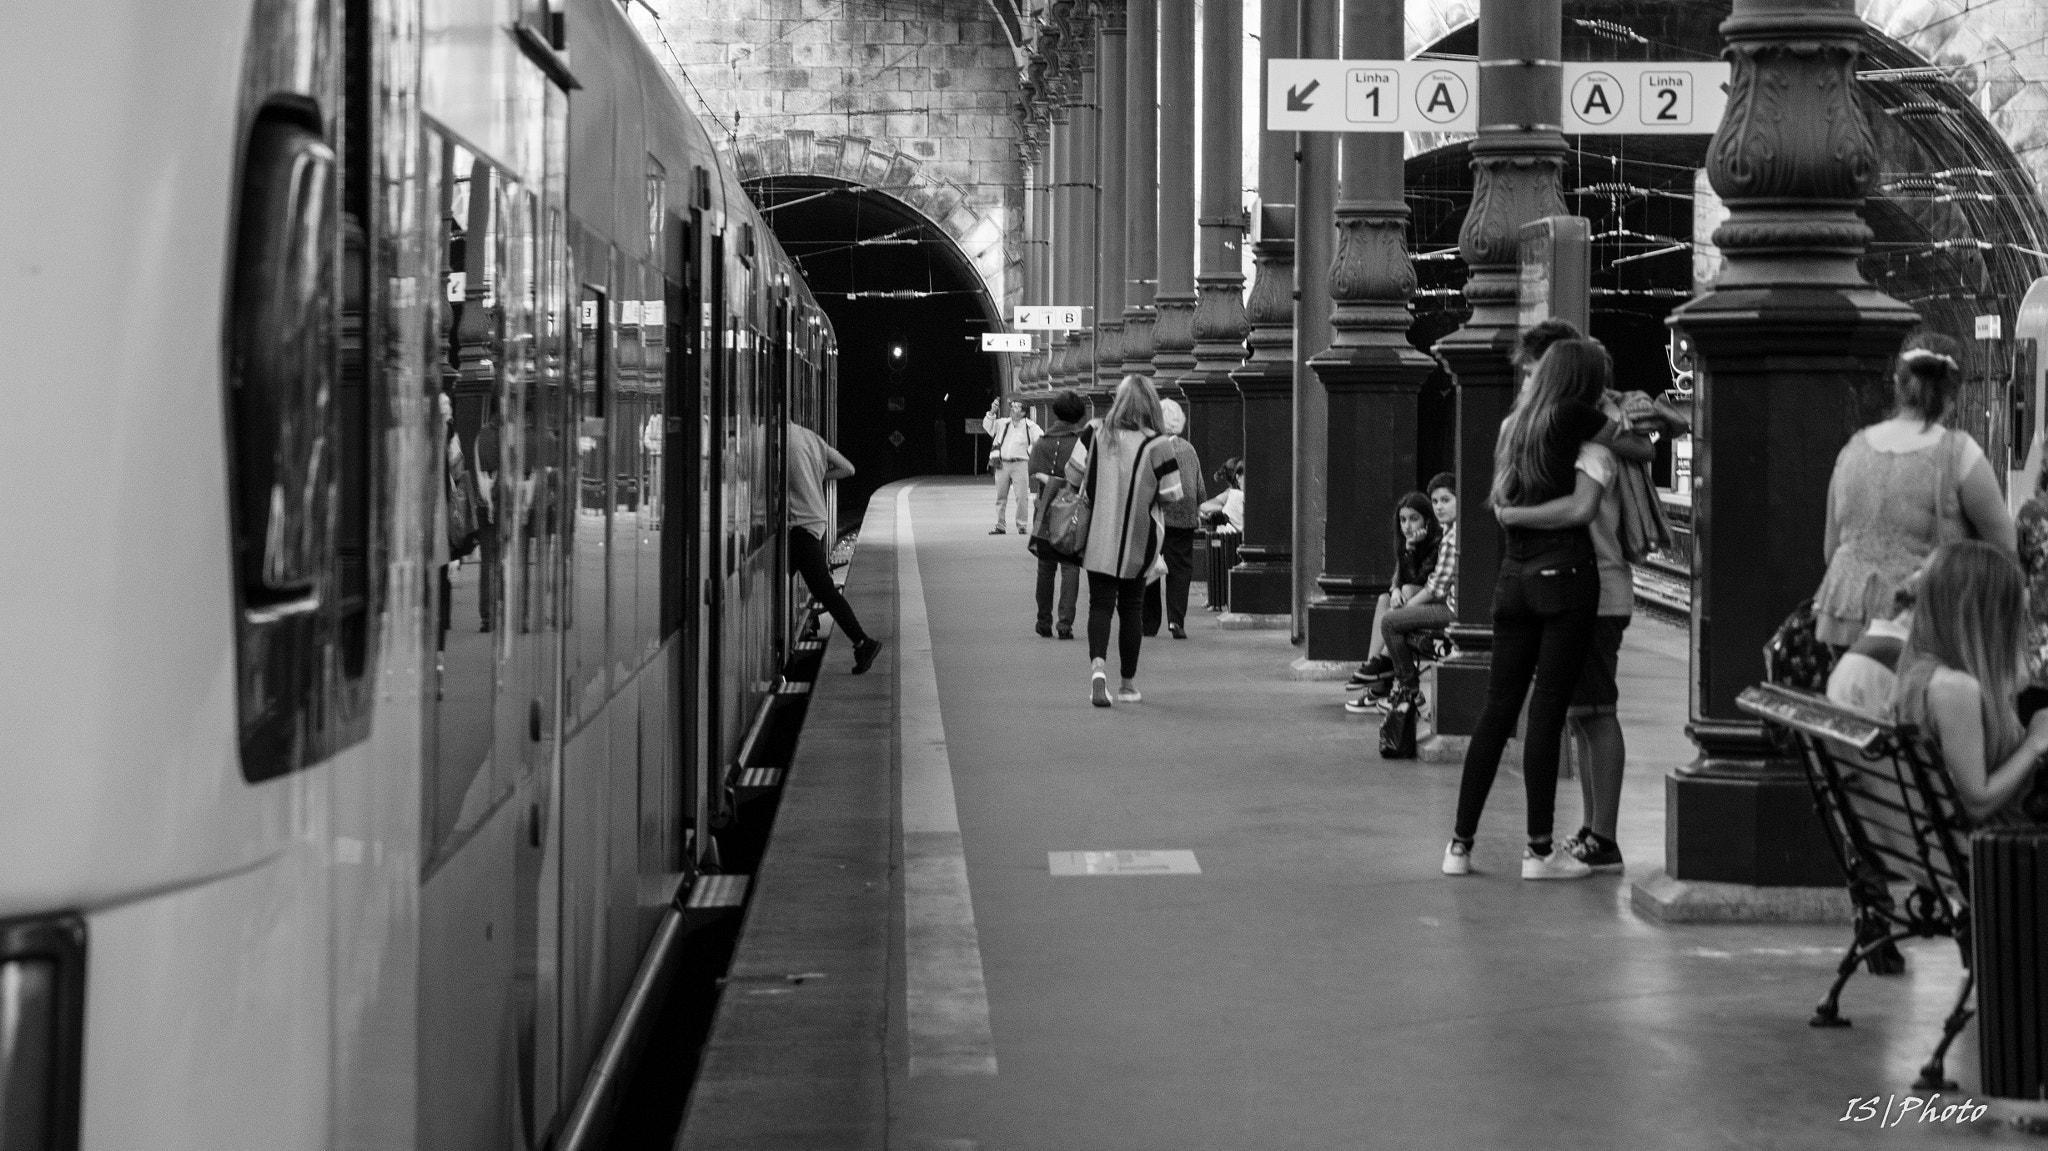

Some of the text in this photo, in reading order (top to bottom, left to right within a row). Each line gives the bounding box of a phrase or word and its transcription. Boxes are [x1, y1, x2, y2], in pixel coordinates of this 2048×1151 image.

[1355, 73, 1390, 83] Linha
[1649, 75, 1683, 86] Linha
[1365, 86, 1379, 117] 1
[1427, 82, 1456, 114] A
[1582, 83, 1612, 115] A
[1656, 88, 1678, 120] 2
[1065, 313, 1074, 323] B
